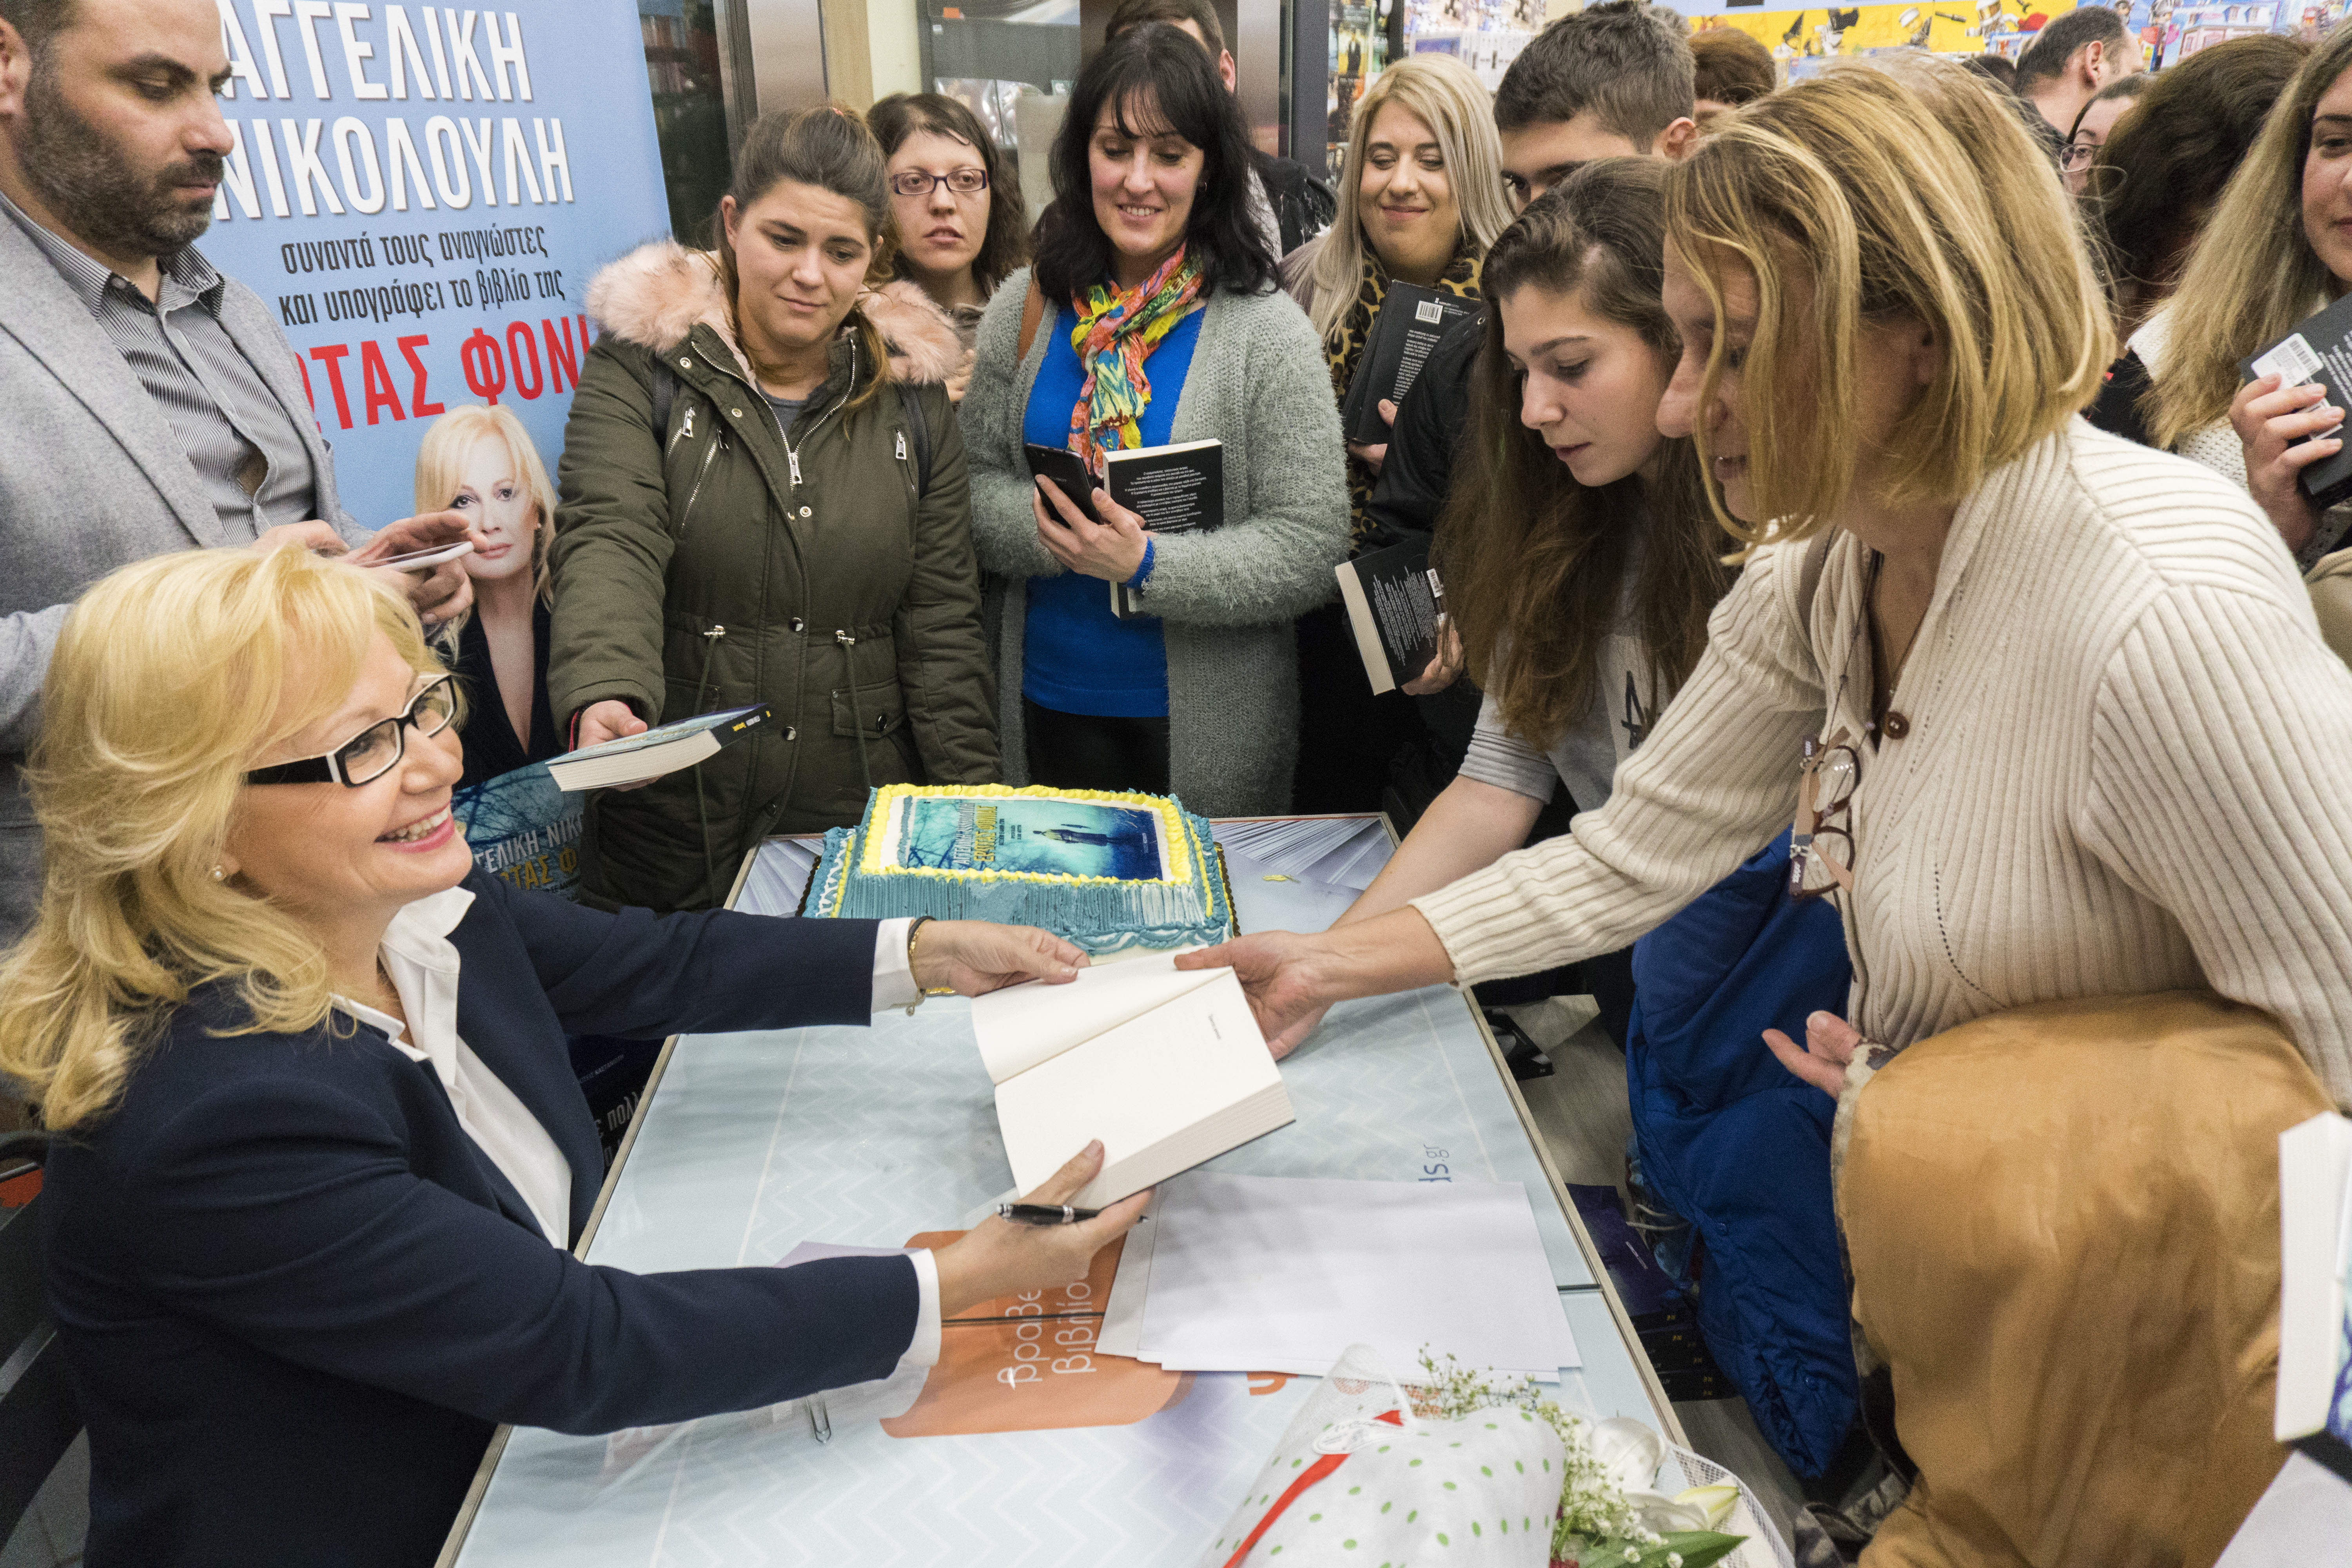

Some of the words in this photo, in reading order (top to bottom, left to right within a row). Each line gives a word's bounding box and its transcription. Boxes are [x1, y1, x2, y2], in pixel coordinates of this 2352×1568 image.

[220, 0, 533, 102] ΑΓΓΕΛΙΚΗ
[214, 115, 573, 220] ΝΙΚΟΛΟΥΛΗ
[280, 231, 376, 274] συναντά
[380, 233, 434, 267] τους
[438, 223, 548, 265] αναγνώστες
[279, 293, 318, 326] και
[323, 279, 445, 323] υπογράφει
[448, 278, 473, 308] το
[476, 268, 530, 311] βιβλίο
[533, 269, 565, 301] της
[976, 805, 997, 830] ΦΟΝΙΑΣ
[974, 831, 996, 862] ΕΡΩΤΑΣ
[500, 855, 553, 890] ΤΑΣ
[608, 1085, 646, 1132] πολλ
